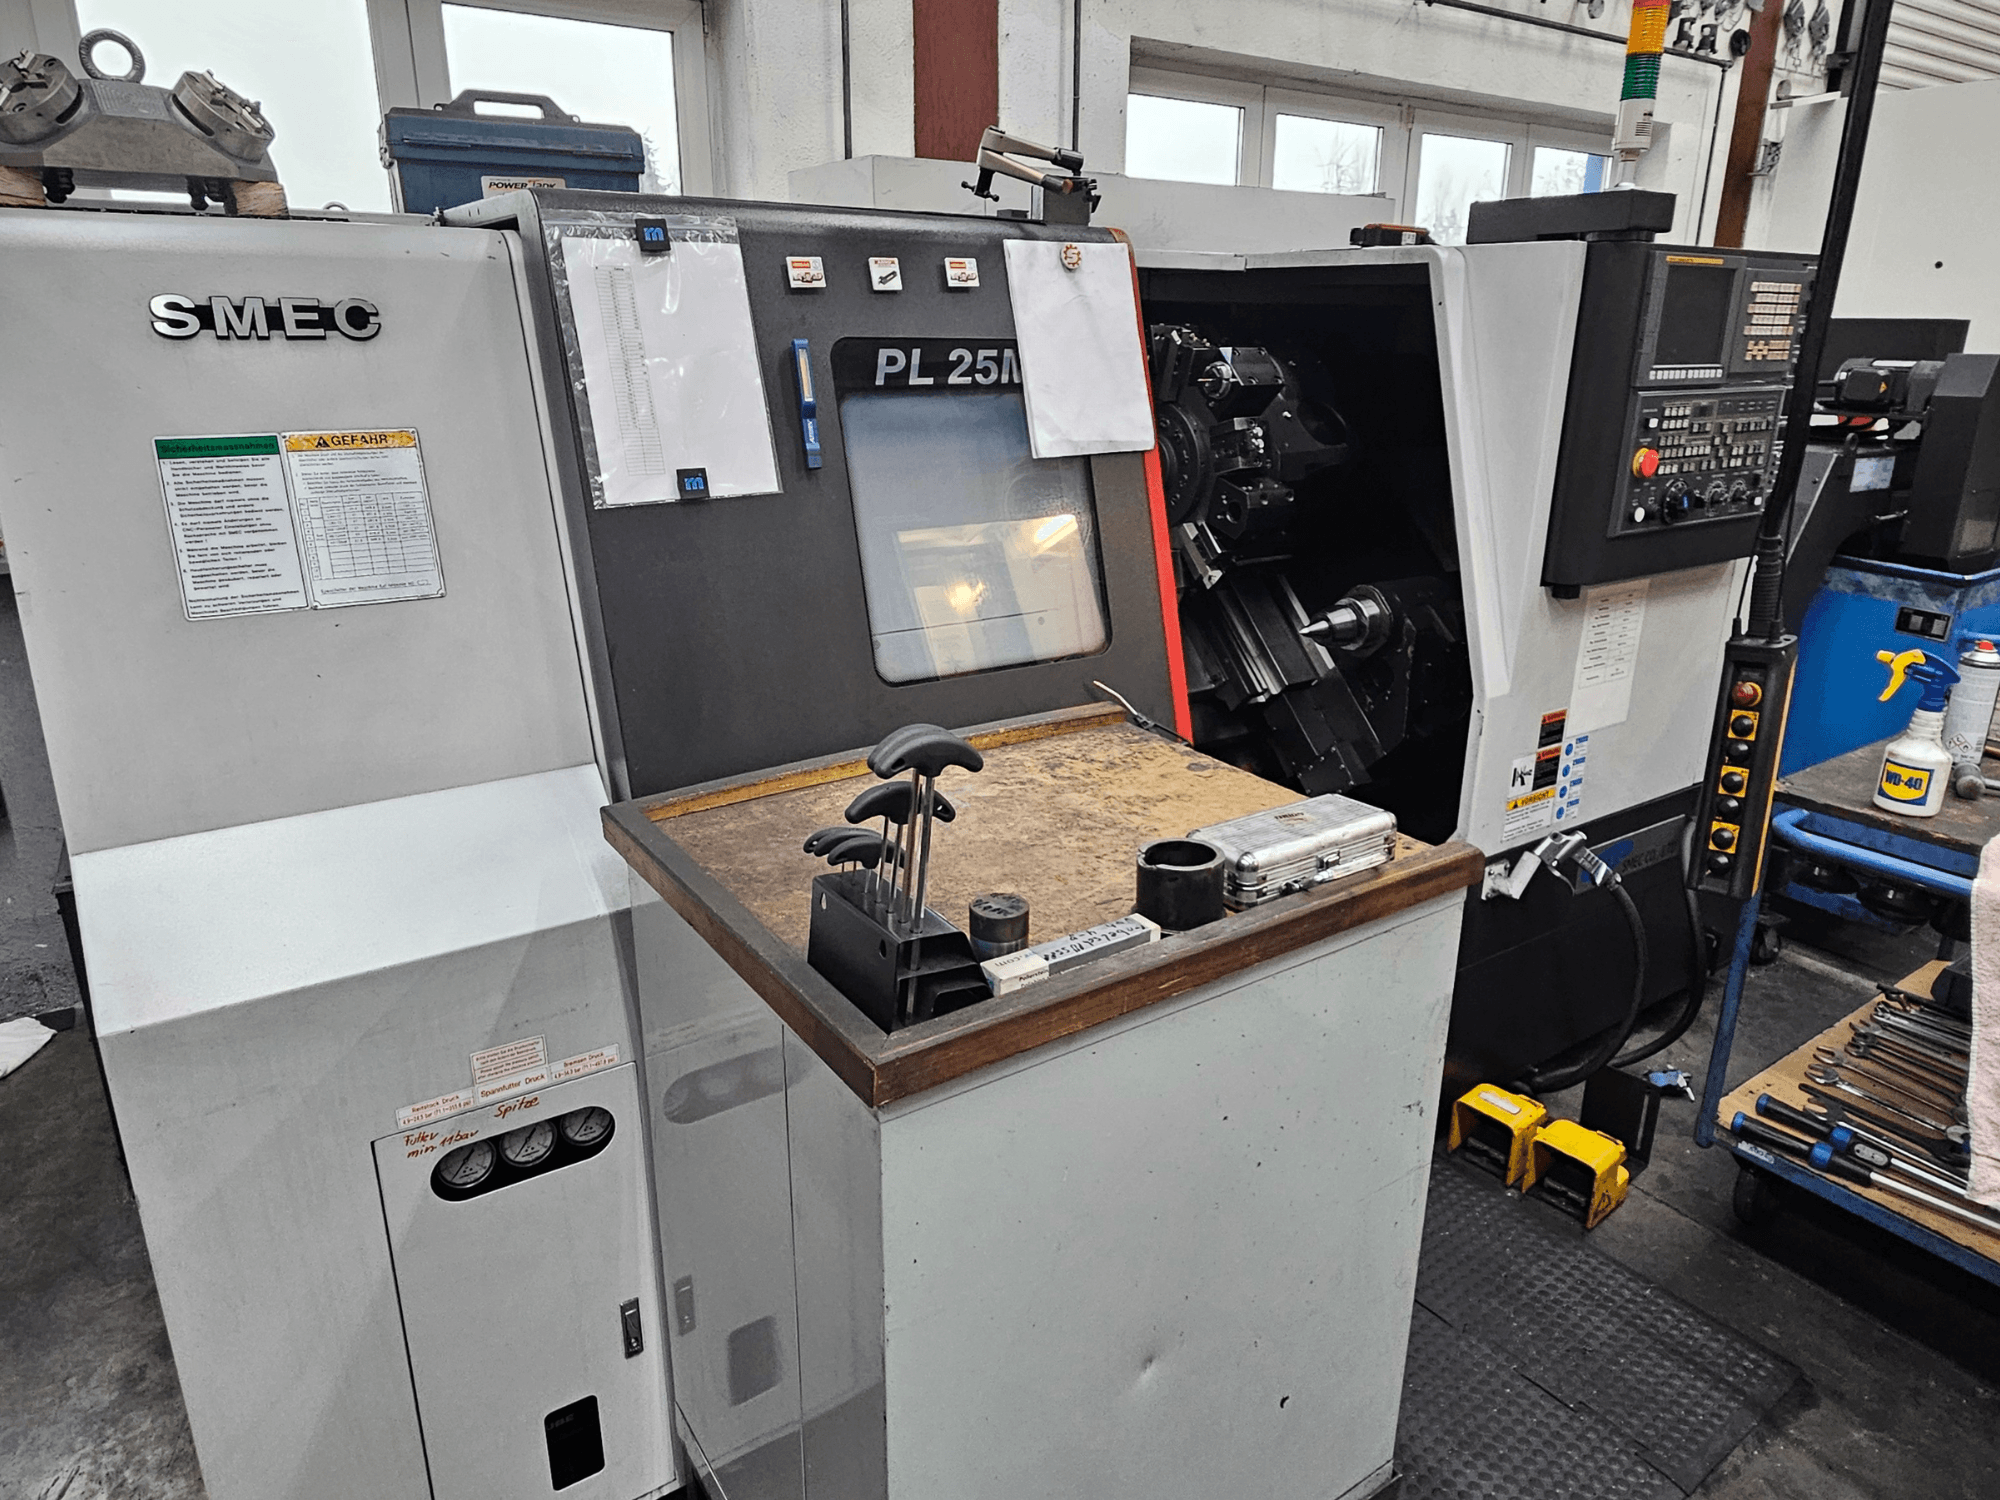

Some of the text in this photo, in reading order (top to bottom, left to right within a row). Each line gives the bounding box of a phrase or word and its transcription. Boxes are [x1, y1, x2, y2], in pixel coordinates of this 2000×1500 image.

[149, 293, 382, 340] SMEC
[875, 348, 934, 386] PL
[331, 434, 388, 446] GEFAHR
[1886, 770, 1923, 790] WD-40
[563, 1052, 604, 1067] Bremsen Druck
[480, 1073, 545, 1098] Spannfutter Druck
[442, 1094, 460, 1105] Druck
[494, 1096, 540, 1119] Spitze
